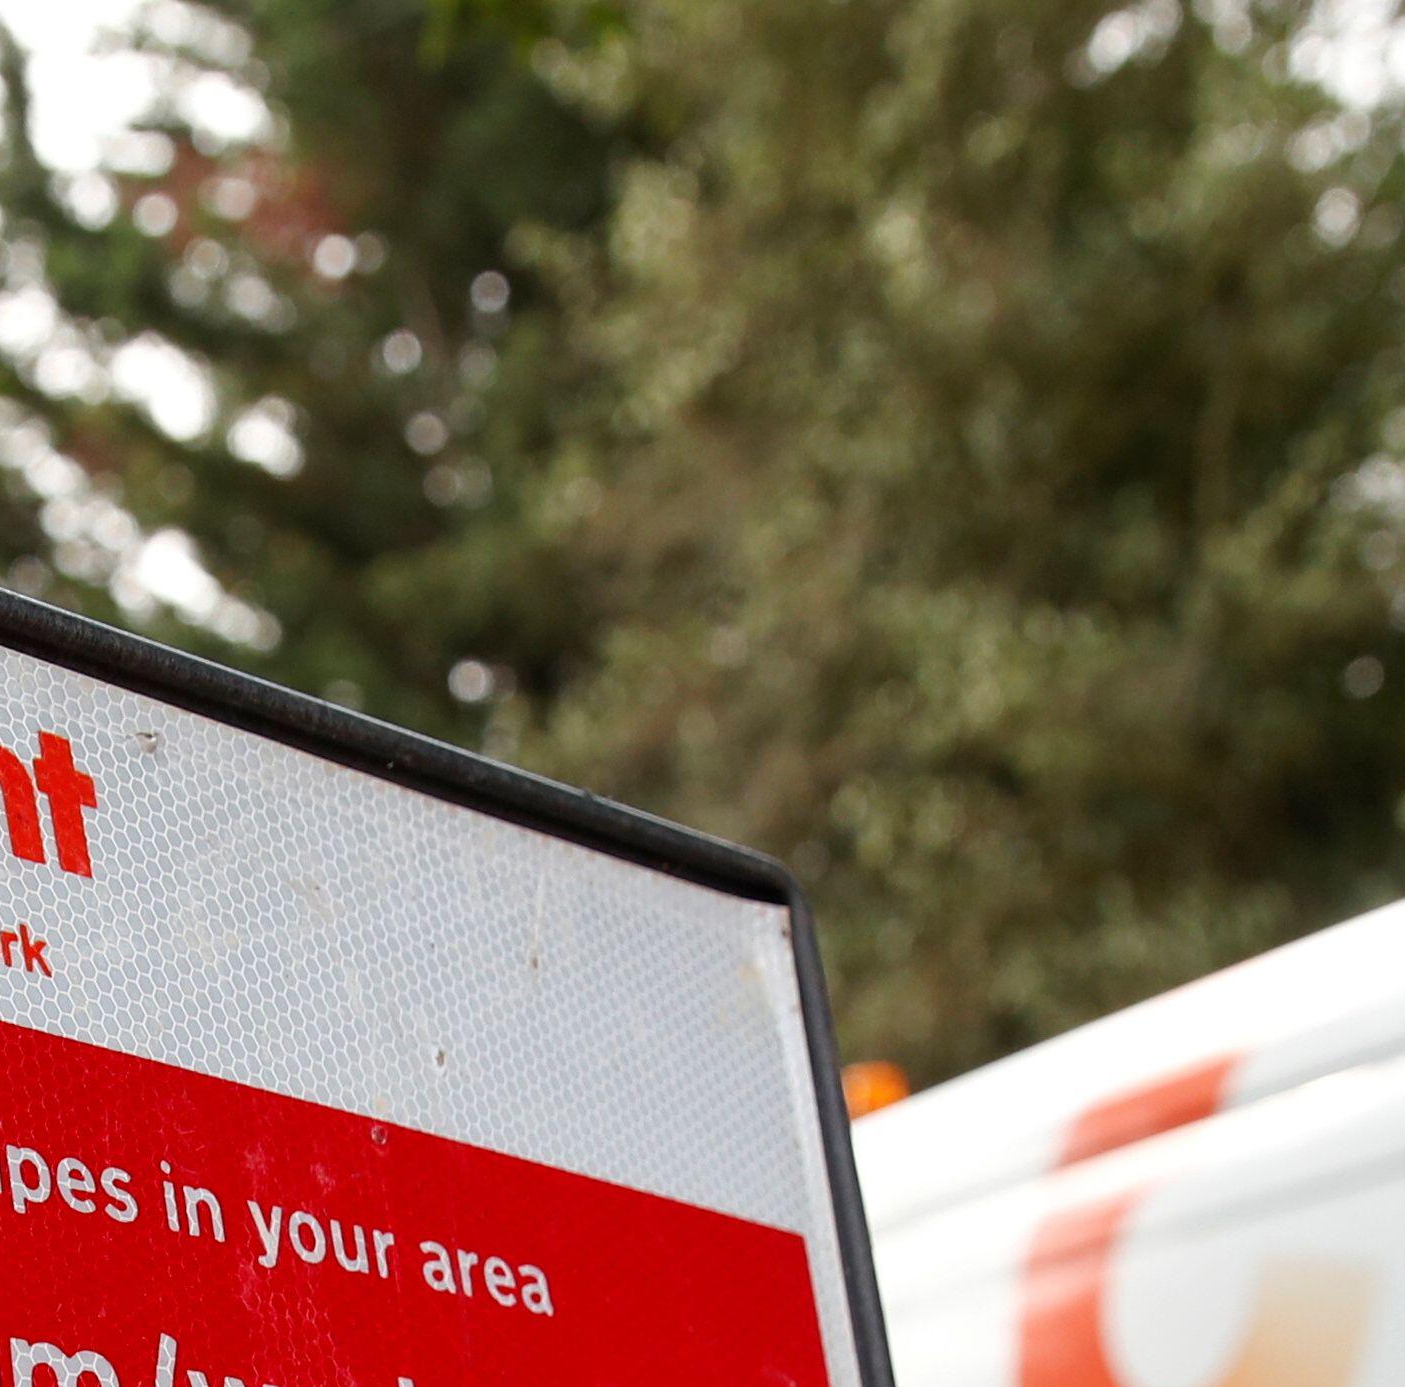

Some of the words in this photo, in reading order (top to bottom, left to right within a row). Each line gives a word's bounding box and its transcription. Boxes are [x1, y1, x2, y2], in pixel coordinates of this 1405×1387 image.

[160, 1160, 225, 1244] in
[247, 1199, 396, 1280] your
[419, 1240, 554, 1317] area
